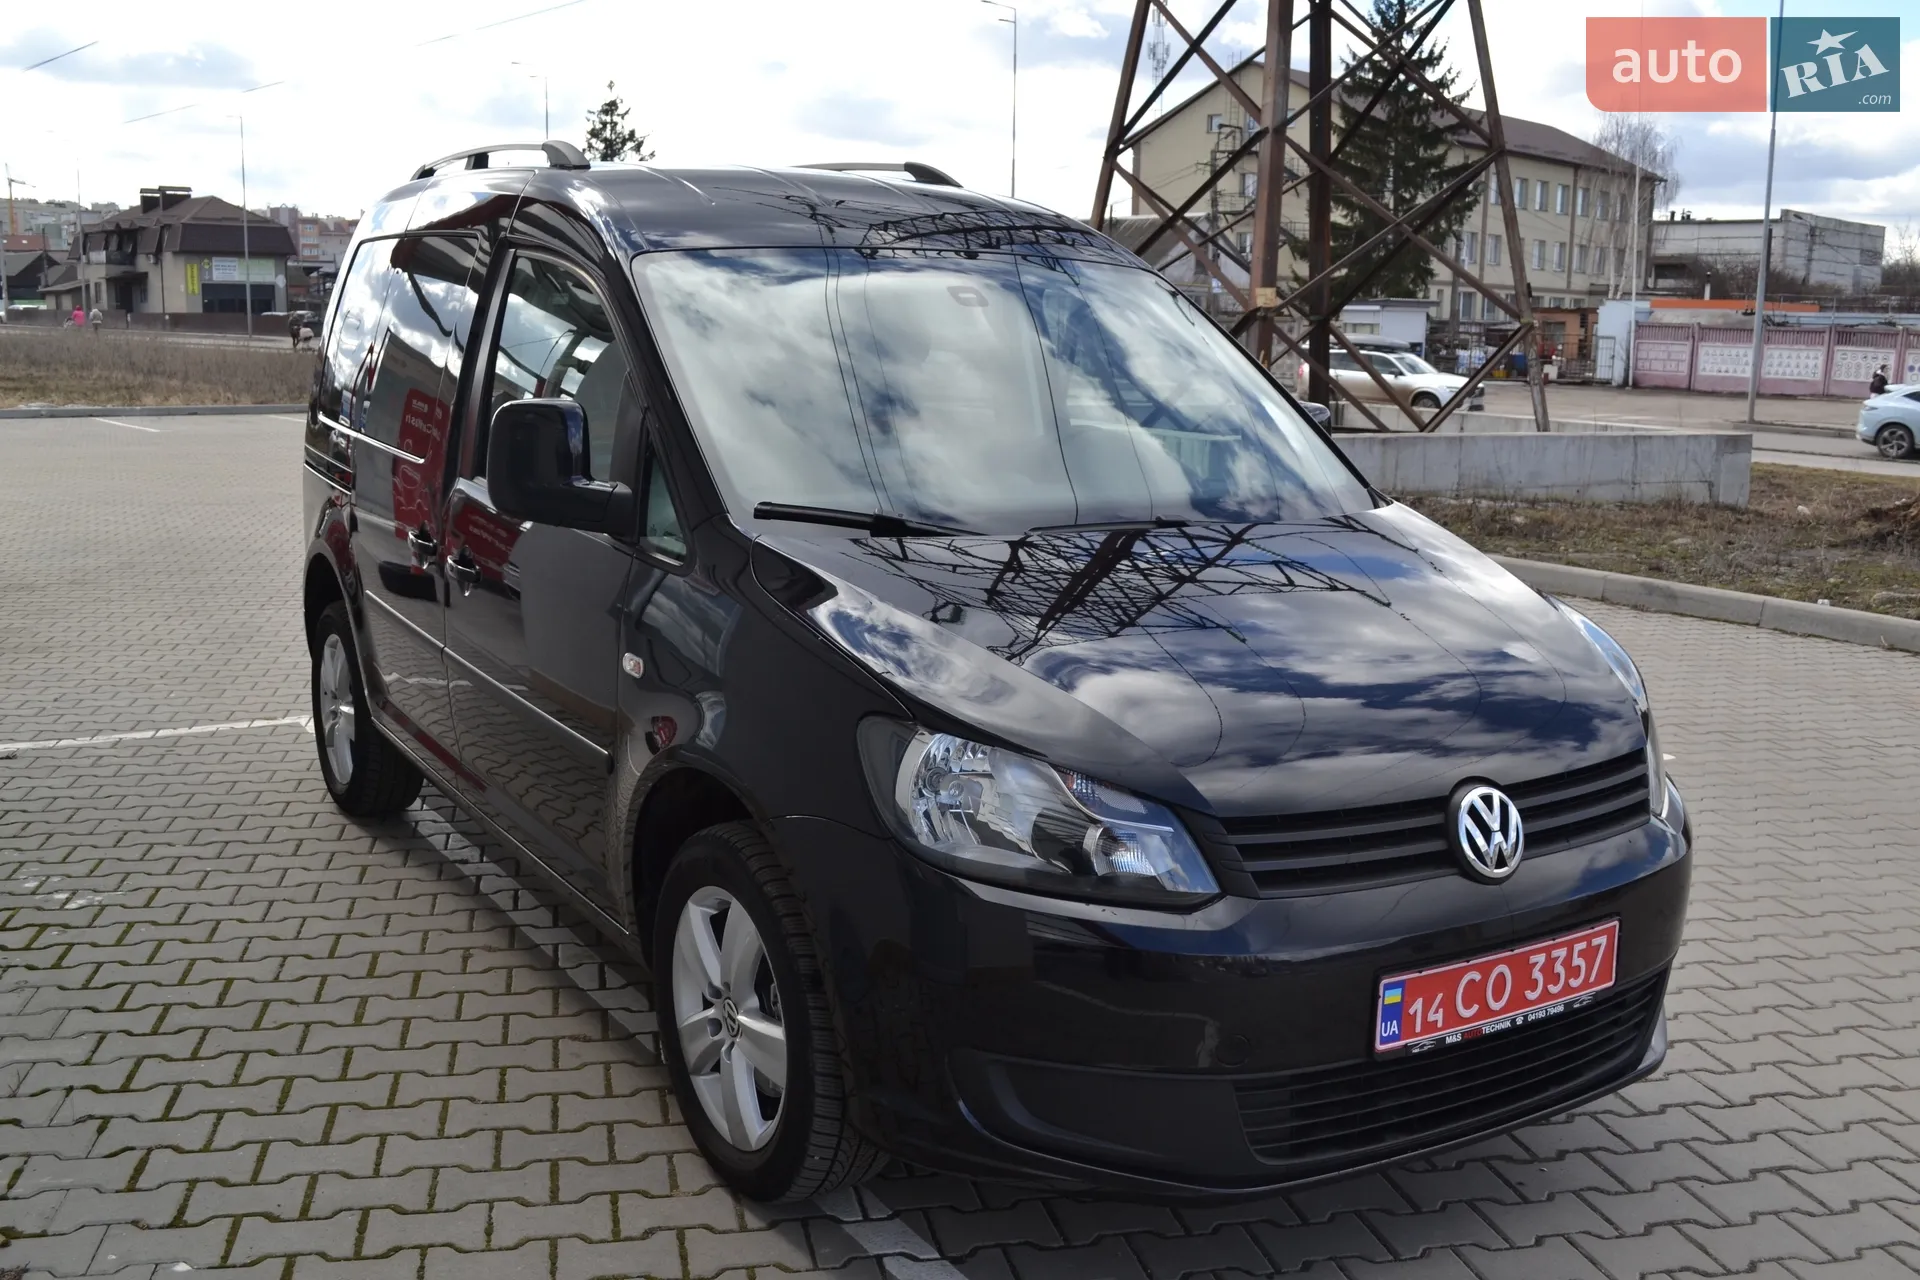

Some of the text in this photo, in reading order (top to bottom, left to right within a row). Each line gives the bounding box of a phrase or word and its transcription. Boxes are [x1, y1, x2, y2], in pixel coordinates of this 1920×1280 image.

[1408, 934, 1608, 1033] 14 CO 3357
[1381, 1021, 1399, 1037] UA
[1445, 1033, 1462, 1044] M&S
[1527, 1009, 1546, 1022] 04193
